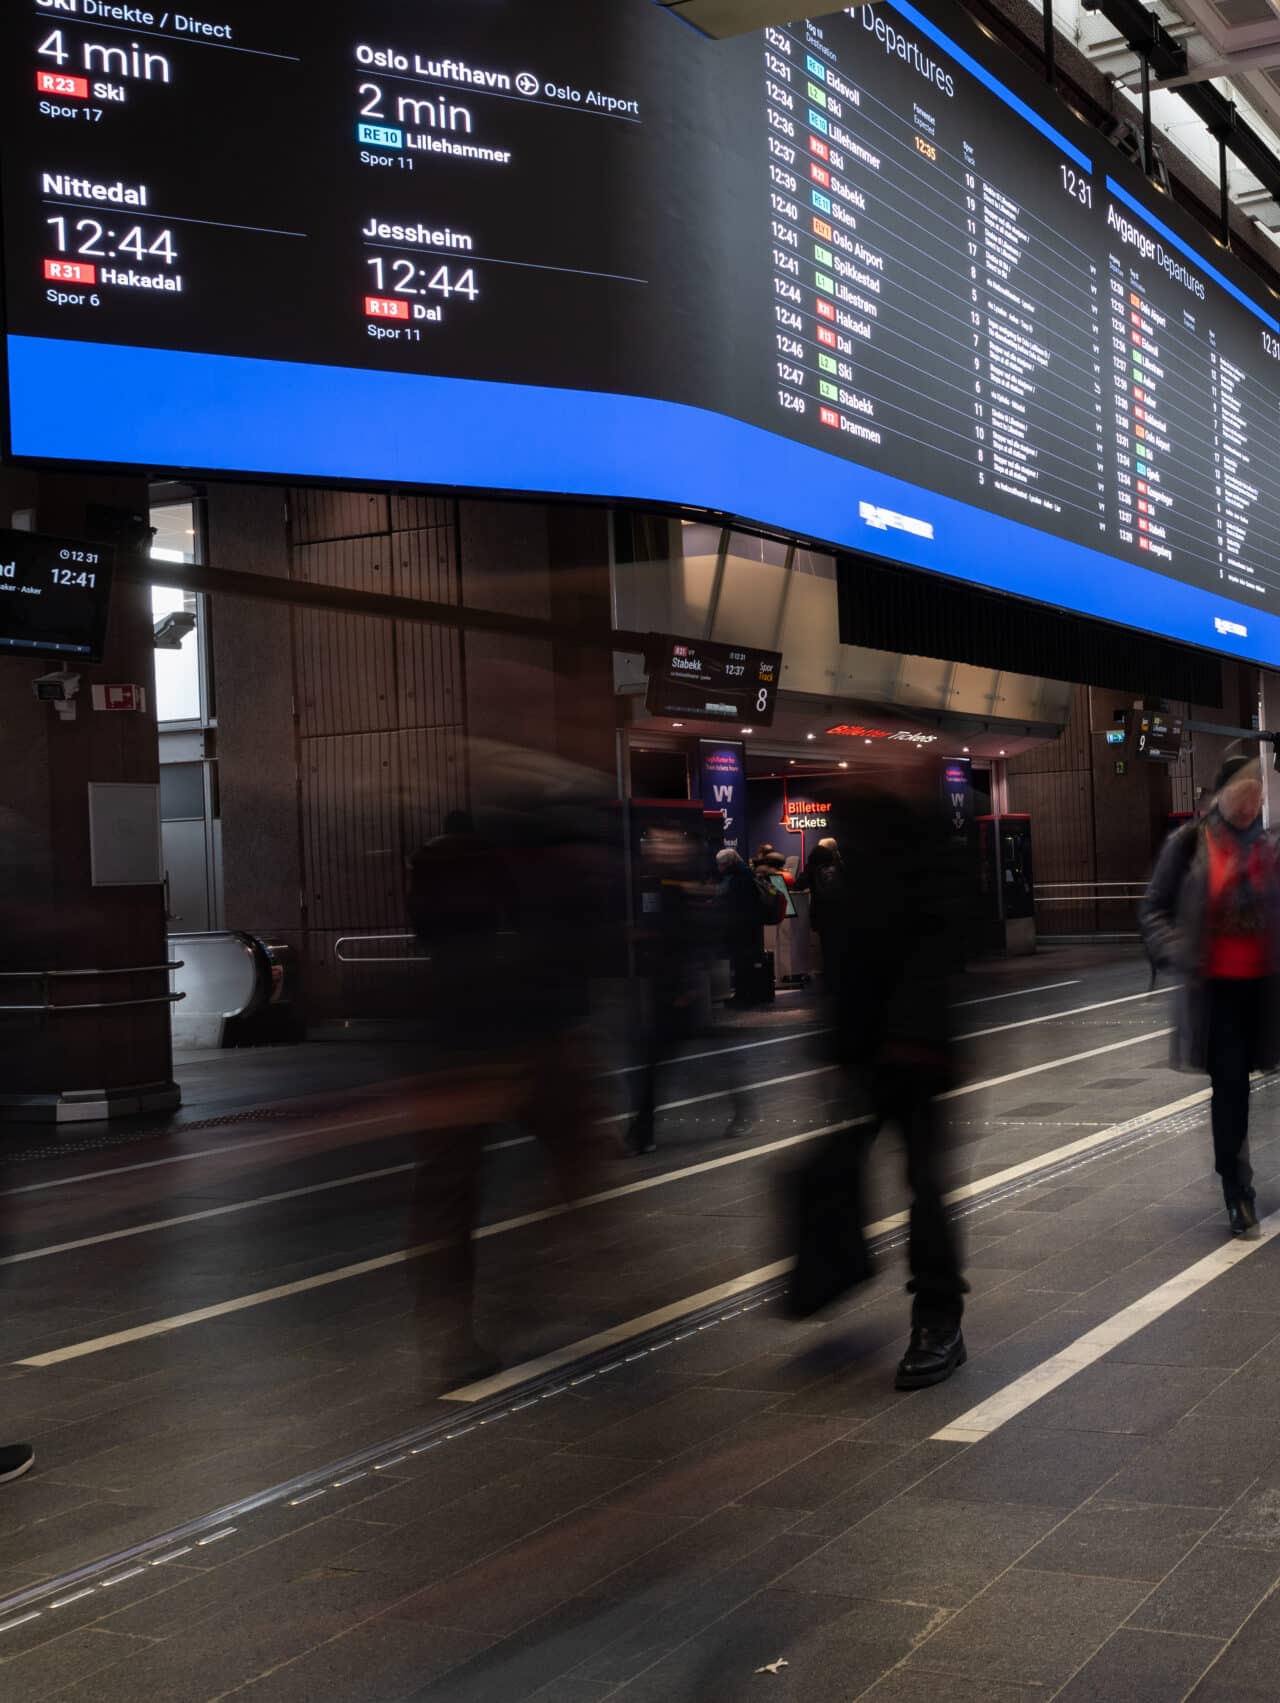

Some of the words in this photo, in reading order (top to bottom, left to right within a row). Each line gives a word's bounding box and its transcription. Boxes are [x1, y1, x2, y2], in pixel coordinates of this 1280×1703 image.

[83, 0, 154, 25] Direkte
[175, 15, 232, 39] Direct
[37, 29, 68, 65] 4
[84, 43, 171, 83] min
[861, 3, 954, 98] Departures
[93, 82, 125, 102] Ski
[356, 45, 408, 70] Oslo
[414, 55, 510, 90] Lufthavn
[544, 83, 581, 102] Oslo
[585, 92, 639, 115] Airport
[765, 53, 791, 81] 12:31
[827, 96, 842, 118] Ski
[765, 27, 791, 55] 12:24
[826, 70, 860, 106] Eidsvoll
[914, 136, 936, 160] 12:35
[39, 101, 78, 119] Spor
[82, 107, 103, 122] 17
[359, 82, 384, 118] 2
[398, 96, 472, 133] min
[766, 81, 793, 110] 12:34
[828, 123, 881, 169] Lillehammer
[360, 151, 393, 168] Spor
[398, 157, 414, 170] 11
[406, 133, 511, 163] Lillehammer
[767, 109, 795, 136] 12:36
[829, 150, 844, 170] Ski
[42, 173, 147, 206] Nittedal
[768, 137, 795, 164] 12:37
[830, 176, 865, 210] Stabekk
[770, 165, 797, 191] 12:39
[832, 204, 856, 229] Skien
[47, 216, 178, 264] 12:44
[362, 218, 472, 250] Jessheim
[771, 194, 798, 220] 12:40
[833, 231, 852, 252] Oslo
[854, 242, 884, 270] Airport
[1107, 204, 1156, 261] Avganger
[1157, 244, 1205, 300] Departures
[101, 268, 182, 292] Hakadal
[367, 257, 479, 301] 12:44
[771, 222, 798, 247] 12:41
[834, 257, 880, 293] Spikkestad
[46, 289, 85, 306] Spor
[89, 293, 100, 306] 6
[773, 250, 799, 275] 12:41
[835, 282, 878, 317] Lillestrøm
[414, 304, 442, 320] Dal
[774, 278, 801, 303] 12:44
[836, 309, 871, 339] Hakadal
[775, 306, 802, 331] 12:44
[837, 336, 852, 355] Dal
[367, 324, 400, 340] Spor
[404, 328, 421, 341] 11
[776, 335, 803, 358] 12:46
[838, 363, 852, 381] Ski
[777, 362, 804, 385] 12:47
[839, 389, 874, 416] Stabekk
[778, 391, 805, 414] 12:49
[840, 416, 881, 444] Drammen
[21, 586, 42, 595] Asker
[51, 568, 96, 589] 12:41
[671, 657, 702, 671] Stabekk
[760, 662, 773, 672] Spor
[756, 688, 768, 712] 8
[888, 730, 938, 743] Tickets
[788, 800, 832, 815] Billetter
[790, 815, 827, 829] Tickets
